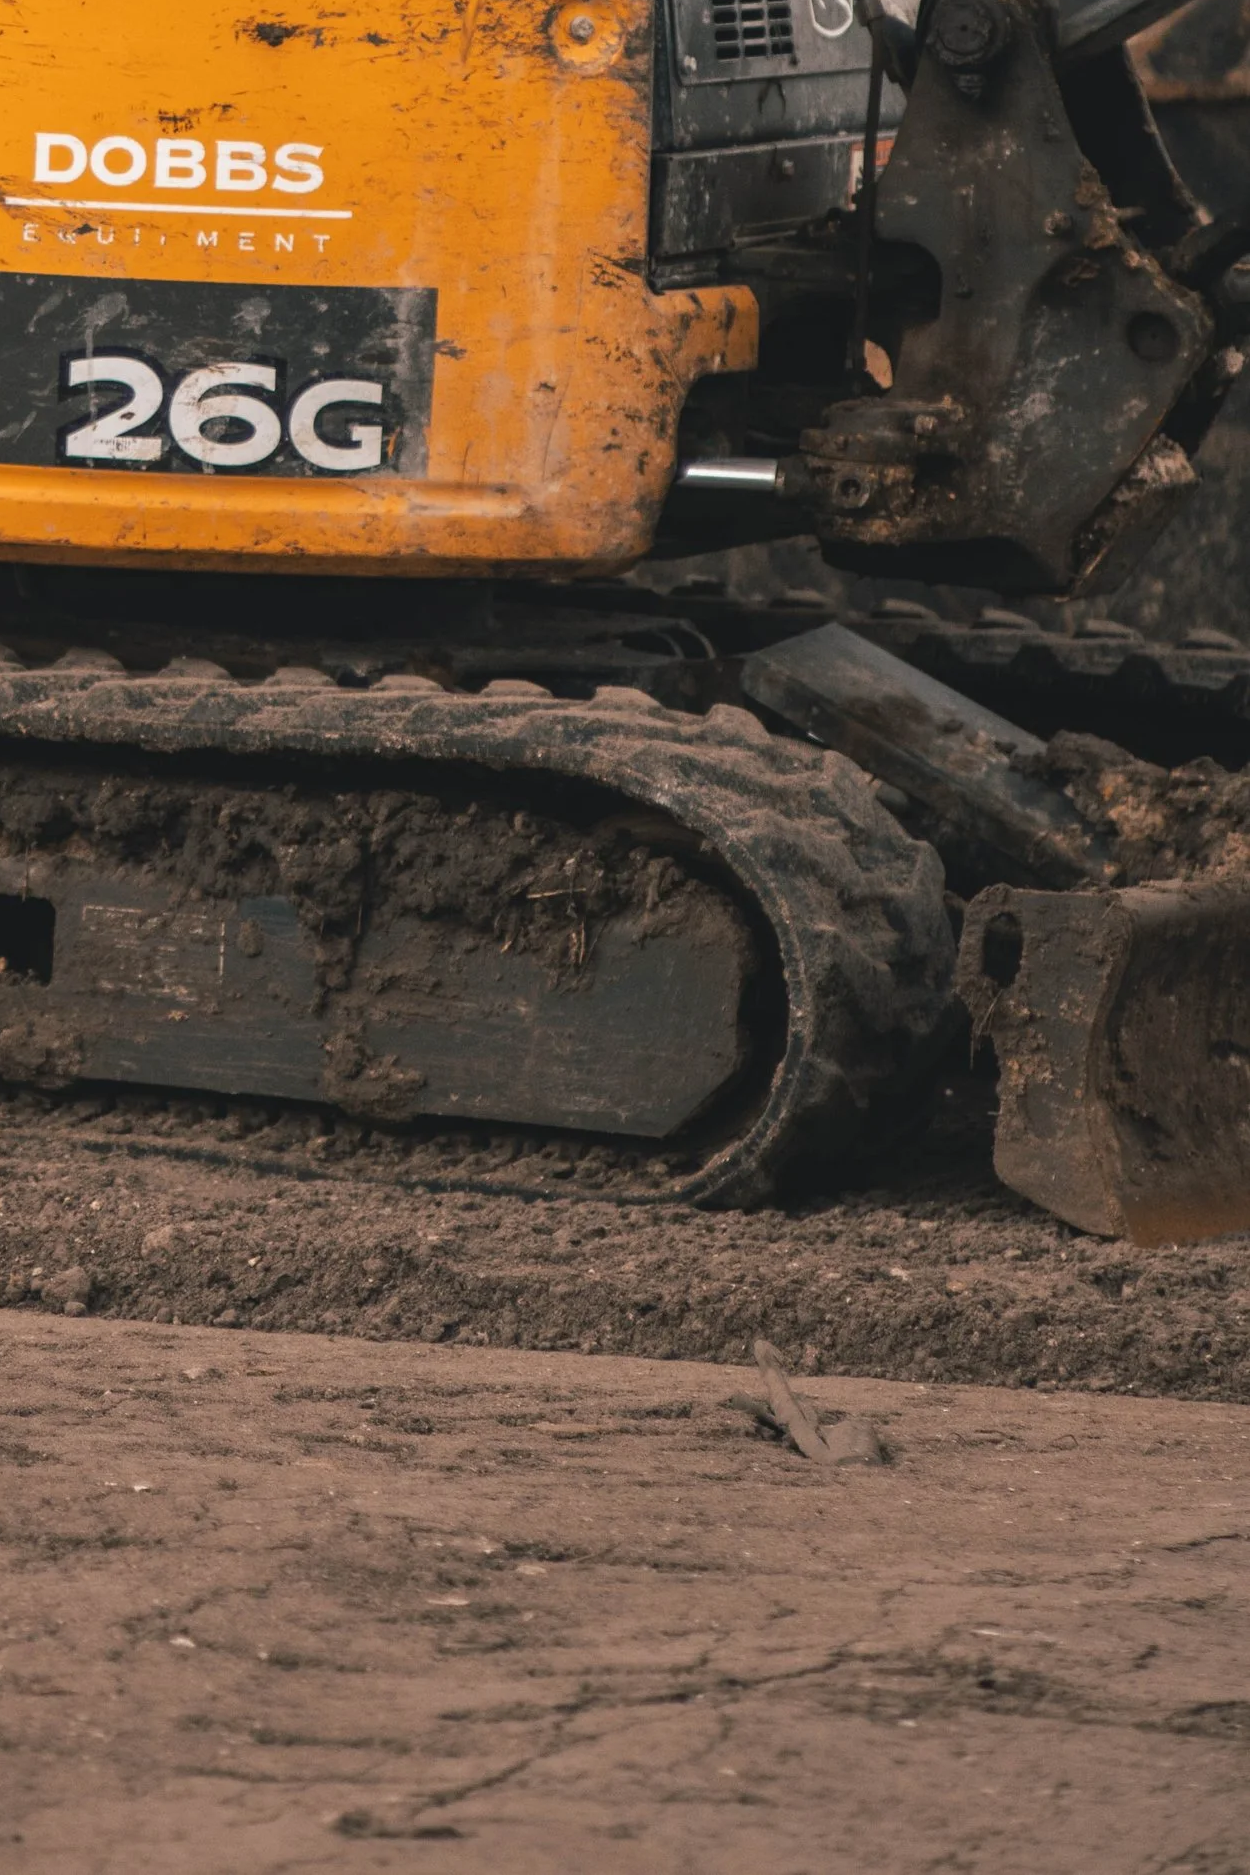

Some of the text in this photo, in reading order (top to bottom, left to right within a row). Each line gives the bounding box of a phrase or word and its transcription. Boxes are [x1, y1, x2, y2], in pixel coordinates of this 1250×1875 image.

[33, 132, 325, 194] DOBBS
[23, 223, 331, 253] EUIMENT
[64, 355, 384, 472] 26G
